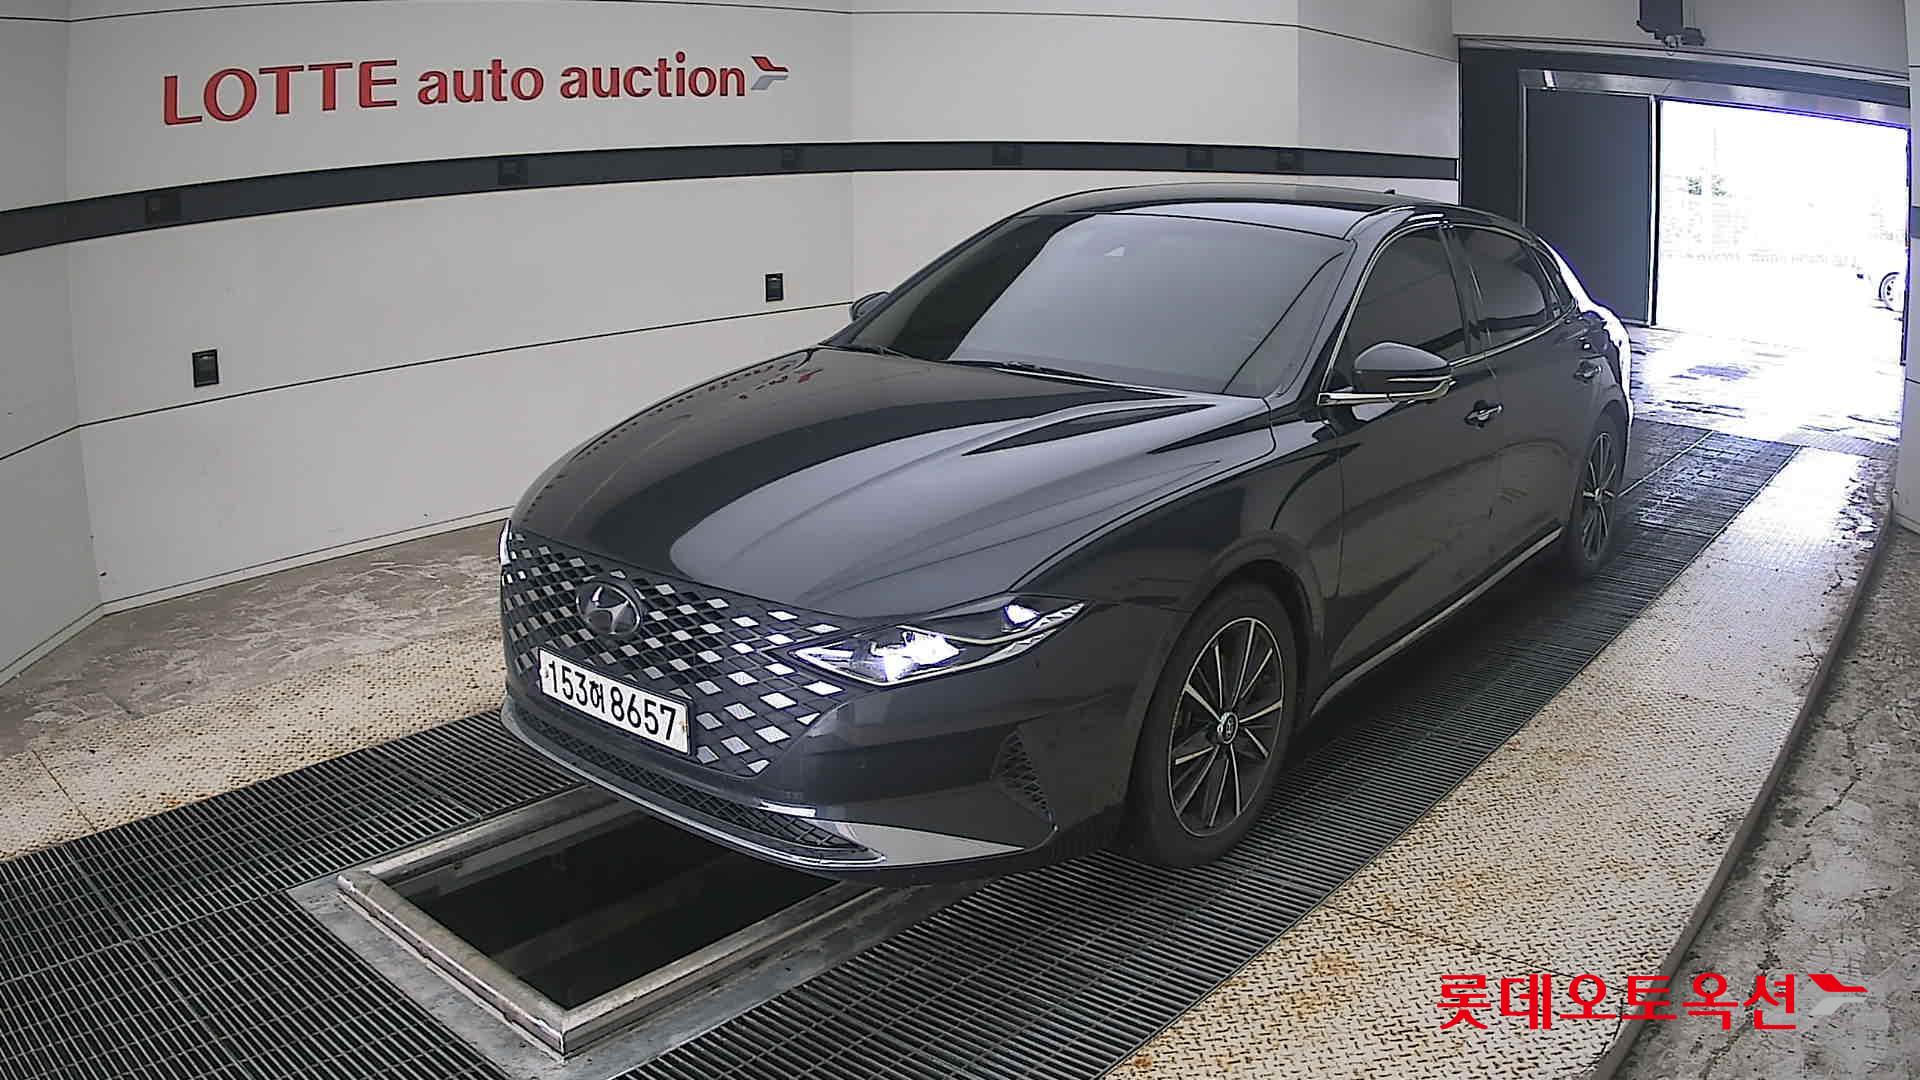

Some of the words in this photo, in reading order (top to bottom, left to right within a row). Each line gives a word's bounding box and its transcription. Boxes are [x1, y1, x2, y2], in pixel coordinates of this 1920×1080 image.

[164, 60, 398, 125] LOTTE
[417, 58, 545, 105] auto
[559, 50, 746, 98] auction
